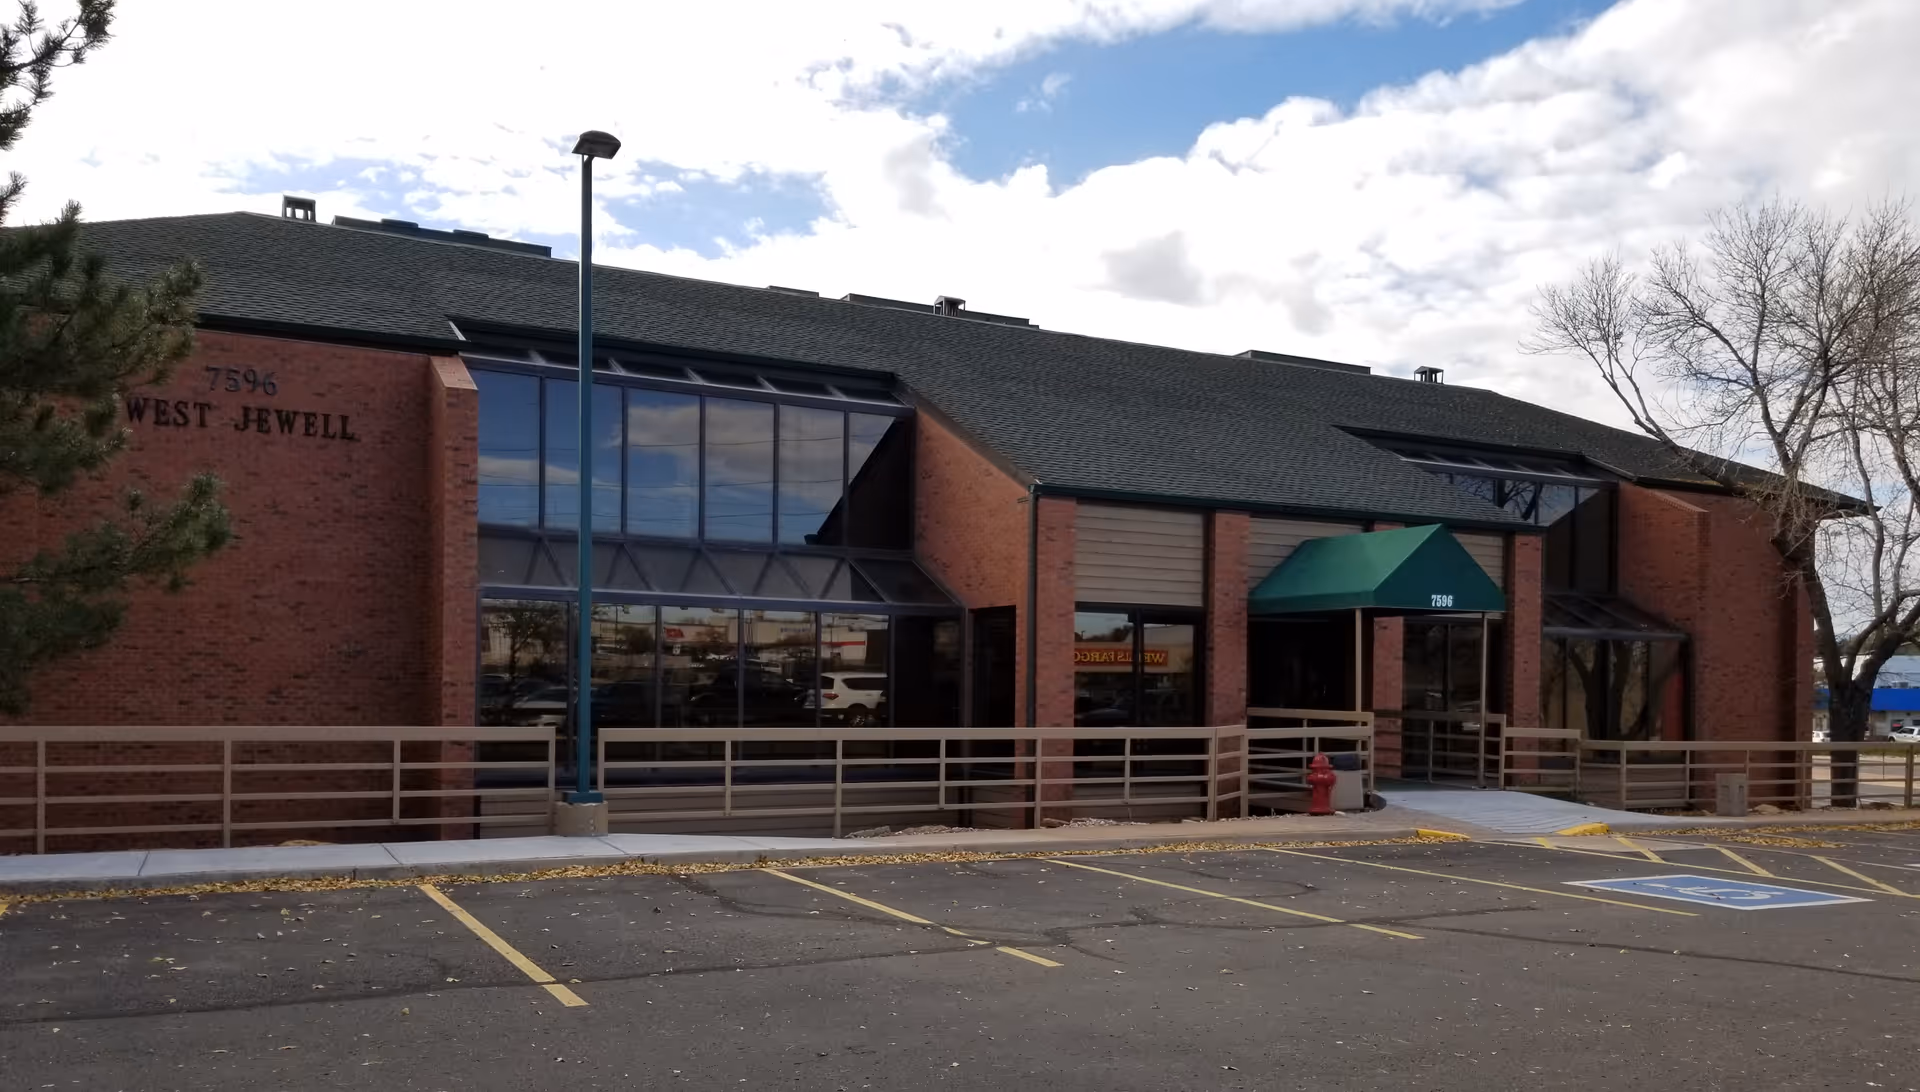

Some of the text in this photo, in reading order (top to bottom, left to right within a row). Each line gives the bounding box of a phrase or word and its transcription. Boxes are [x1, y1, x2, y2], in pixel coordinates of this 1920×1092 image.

[206, 366, 278, 396] 7596
[126, 398, 357, 441] WEST JEWELL
[1431, 594, 1453, 607] 7596
